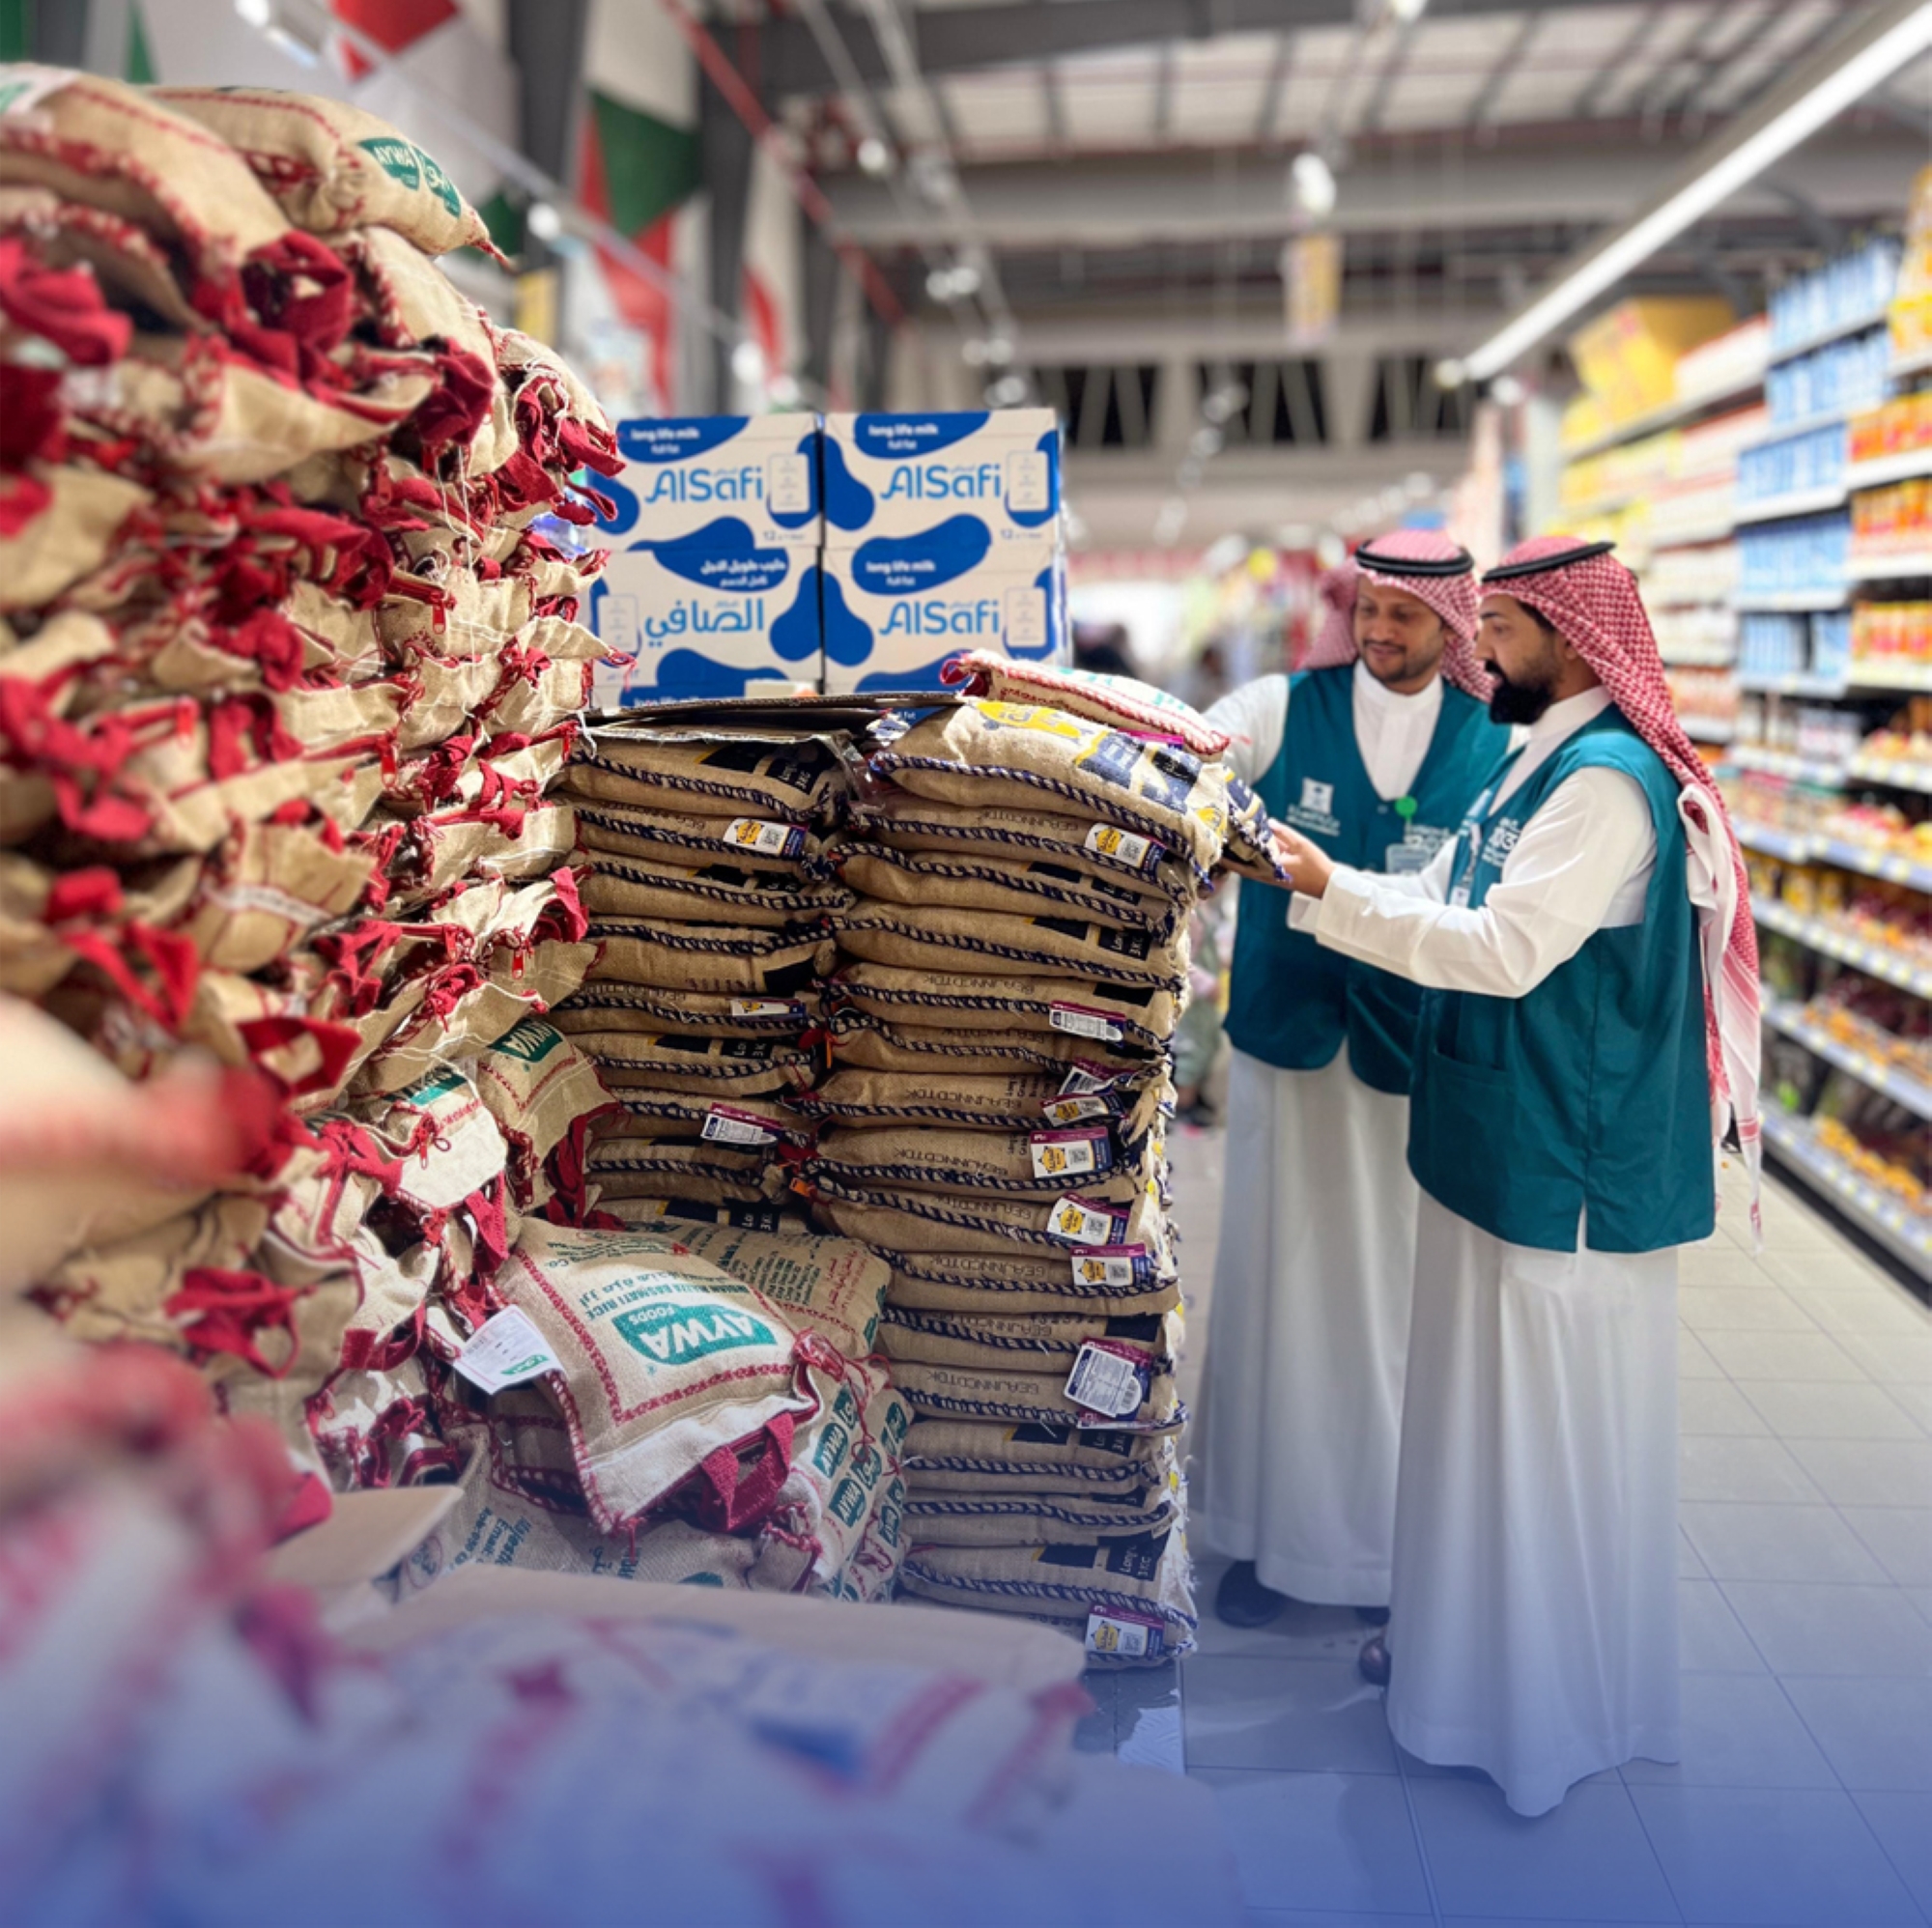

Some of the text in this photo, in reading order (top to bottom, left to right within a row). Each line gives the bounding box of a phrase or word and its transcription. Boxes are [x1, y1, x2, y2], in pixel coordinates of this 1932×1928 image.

[631, 427, 700, 442] long life milk
[868, 423, 939, 438] long life milk
[644, 467, 764, 503] AlSafi
[880, 464, 1001, 500] AlSafi
[867, 560, 936, 574] long life milk
[644, 598, 764, 647] الصافي
[879, 600, 1000, 637] AlSafi
[585, 1299, 618, 1320] RICE
[618, 1285, 672, 1305] BASMATI
[629, 1306, 674, 1325] FOODS
[639, 1315, 753, 1359] AYWA
[819, 1425, 845, 1473] AYWA
[837, 1481, 861, 1521] AYWA
